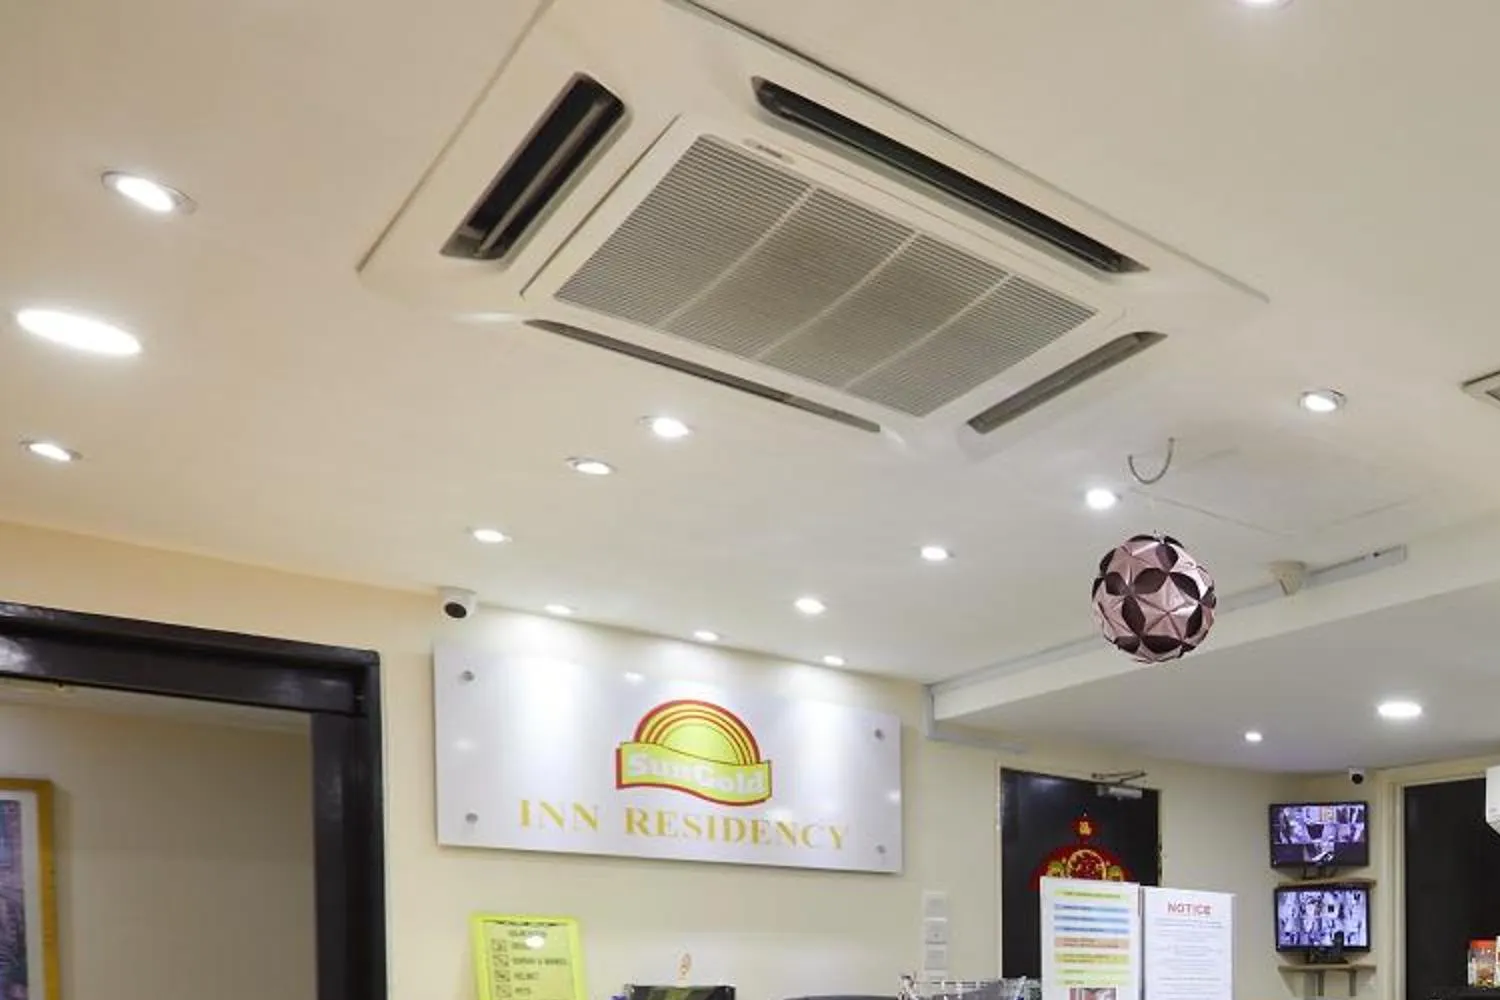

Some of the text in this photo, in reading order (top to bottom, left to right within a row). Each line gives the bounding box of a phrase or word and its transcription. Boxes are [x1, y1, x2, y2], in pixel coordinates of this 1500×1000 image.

[628, 753, 765, 794] SunGold
[519, 799, 847, 849] INN RESIDENCY
[1167, 902, 1211, 915] NOTICE
